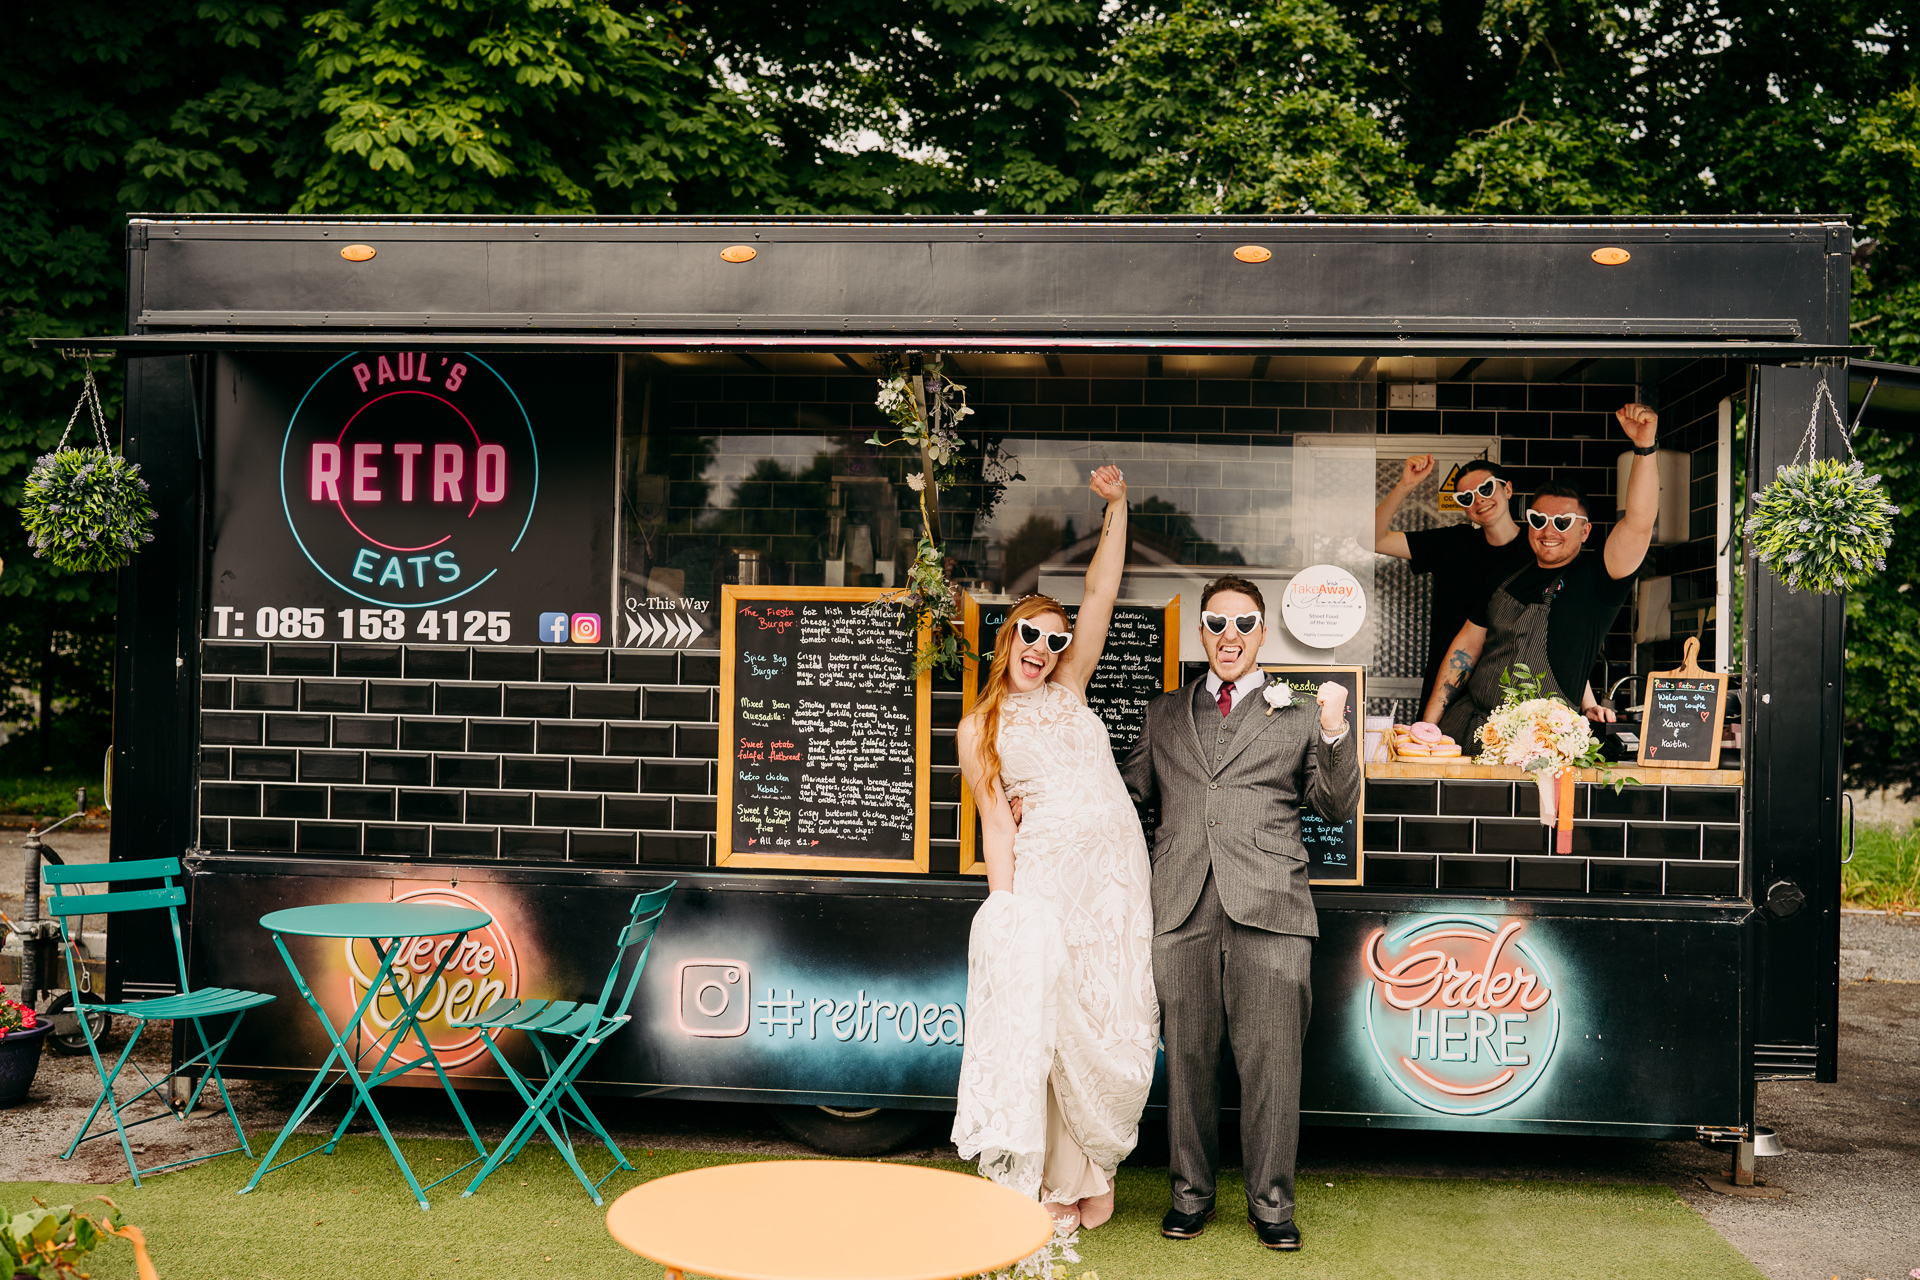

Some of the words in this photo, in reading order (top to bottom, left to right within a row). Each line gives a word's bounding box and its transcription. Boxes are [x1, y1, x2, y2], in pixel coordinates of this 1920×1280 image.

[352, 352, 468, 393] PAUL'S
[310, 442, 507, 503] RETRO
[352, 547, 461, 589] EATS
[1291, 583, 1353, 597] TakeAway
[678, 597, 710, 613] Way
[739, 606, 759, 616] The
[767, 607, 795, 617] Fiesta
[213, 605, 244, 638] T:
[255, 606, 325, 639] 085
[338, 608, 406, 641] 153
[416, 610, 512, 643] 4125
[800, 636, 826, 644] tomato
[858, 636, 874, 644] with
[744, 651, 766, 665] Spice
[773, 654, 787, 667] Bag
[829, 653, 867, 661] buttermilk
[1654, 679, 1675, 689] Paul's
[740, 697, 764, 708] Mixed
[772, 700, 790, 710] Bean
[1659, 702, 1676, 713] happy
[1685, 702, 1706, 712] couple
[1662, 719, 1690, 728] Xavier
[1673, 728, 1679, 738] &
[740, 738, 764, 748] Sweet
[770, 740, 794, 752] potato
[808, 738, 830, 746] Sweet
[835, 739, 856, 748] potato
[737, 749, 764, 762] falafel
[740, 771, 760, 781] Retro
[765, 772, 789, 782] chicken
[737, 804, 760, 815] Sweet
[1317, 825, 1343, 835] topped
[760, 837, 771, 845] All
[776, 837, 791, 847] dips
[1324, 853, 1346, 861] 12.50
[434, 935, 495, 975] are
[1366, 921, 1552, 1011] Order
[757, 986, 966, 1049] #retroea
[1410, 1007, 1530, 1066] HERE
